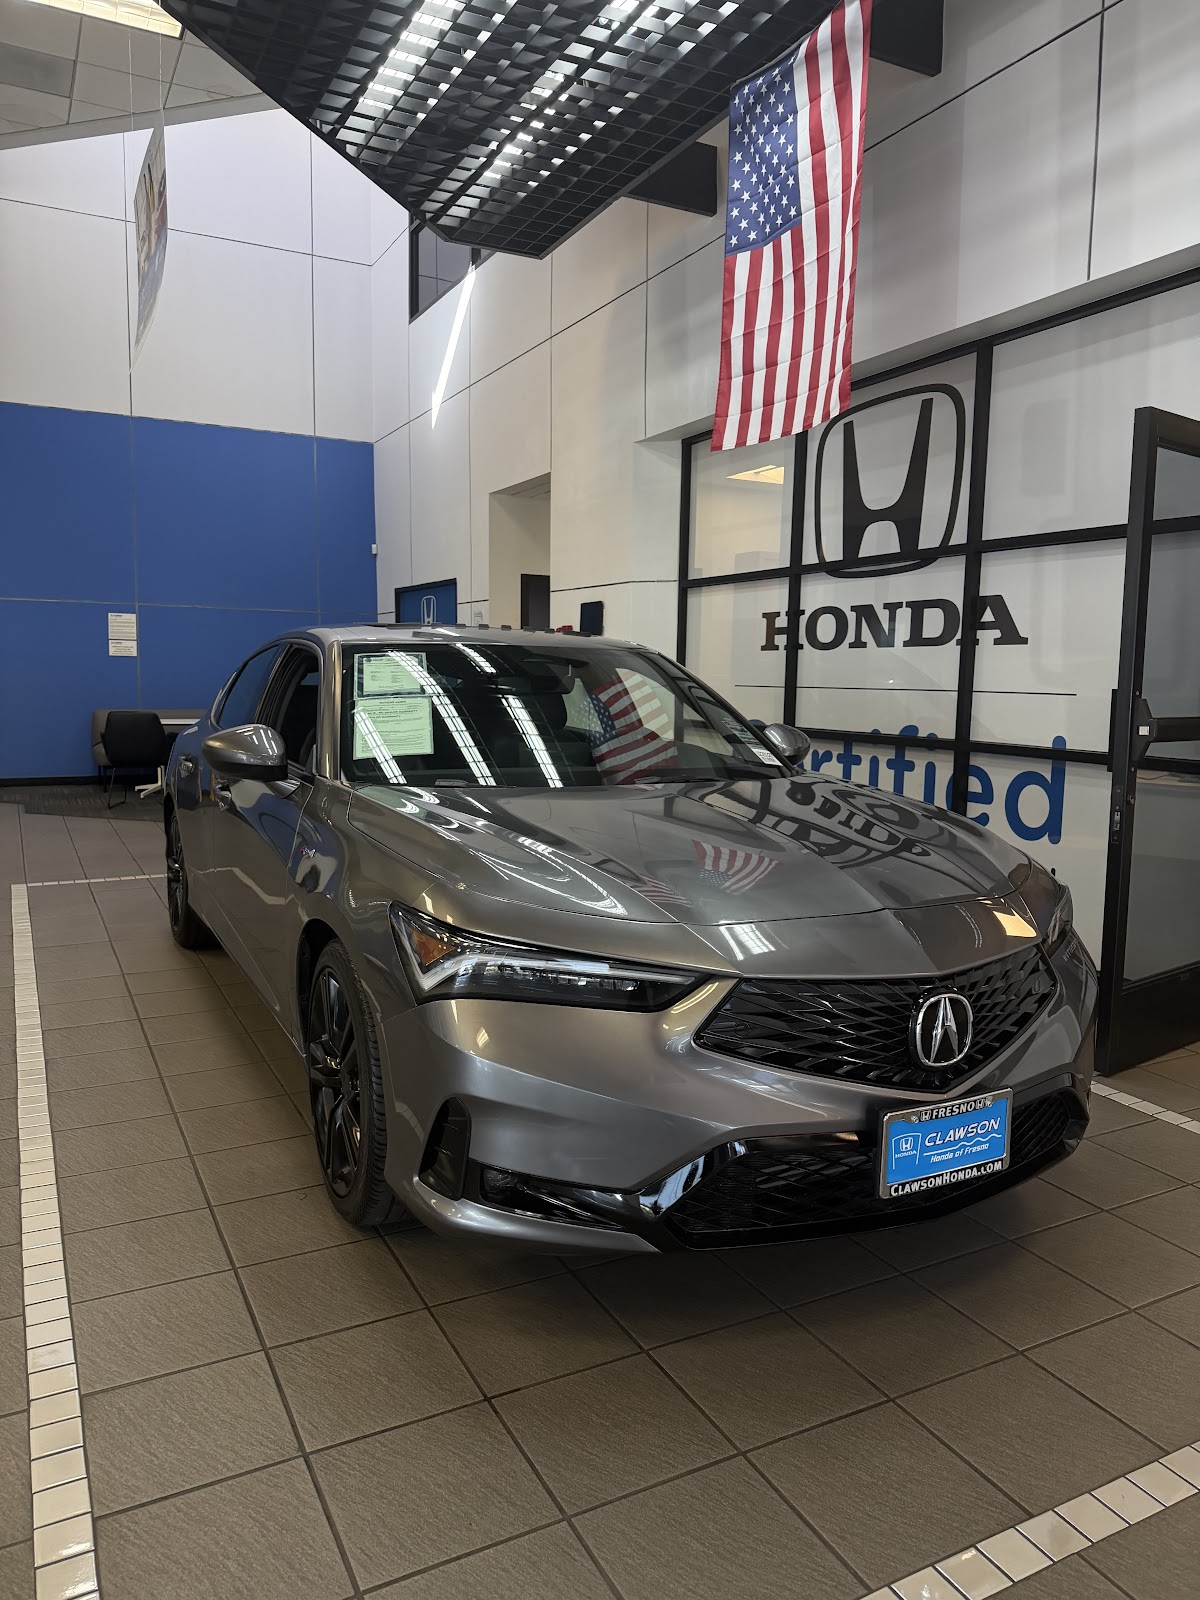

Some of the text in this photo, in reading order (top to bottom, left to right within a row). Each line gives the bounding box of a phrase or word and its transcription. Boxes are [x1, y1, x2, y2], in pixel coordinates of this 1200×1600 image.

[761, 595, 1028, 651] HONDA
[748, 719, 1067, 845] rtified
[933, 1101, 975, 1120] FRESNO
[924, 1117, 1001, 1146] CLAWSON
[895, 1150, 917, 1159] HONDA
[930, 1143, 990, 1163] Honda of Fresno
